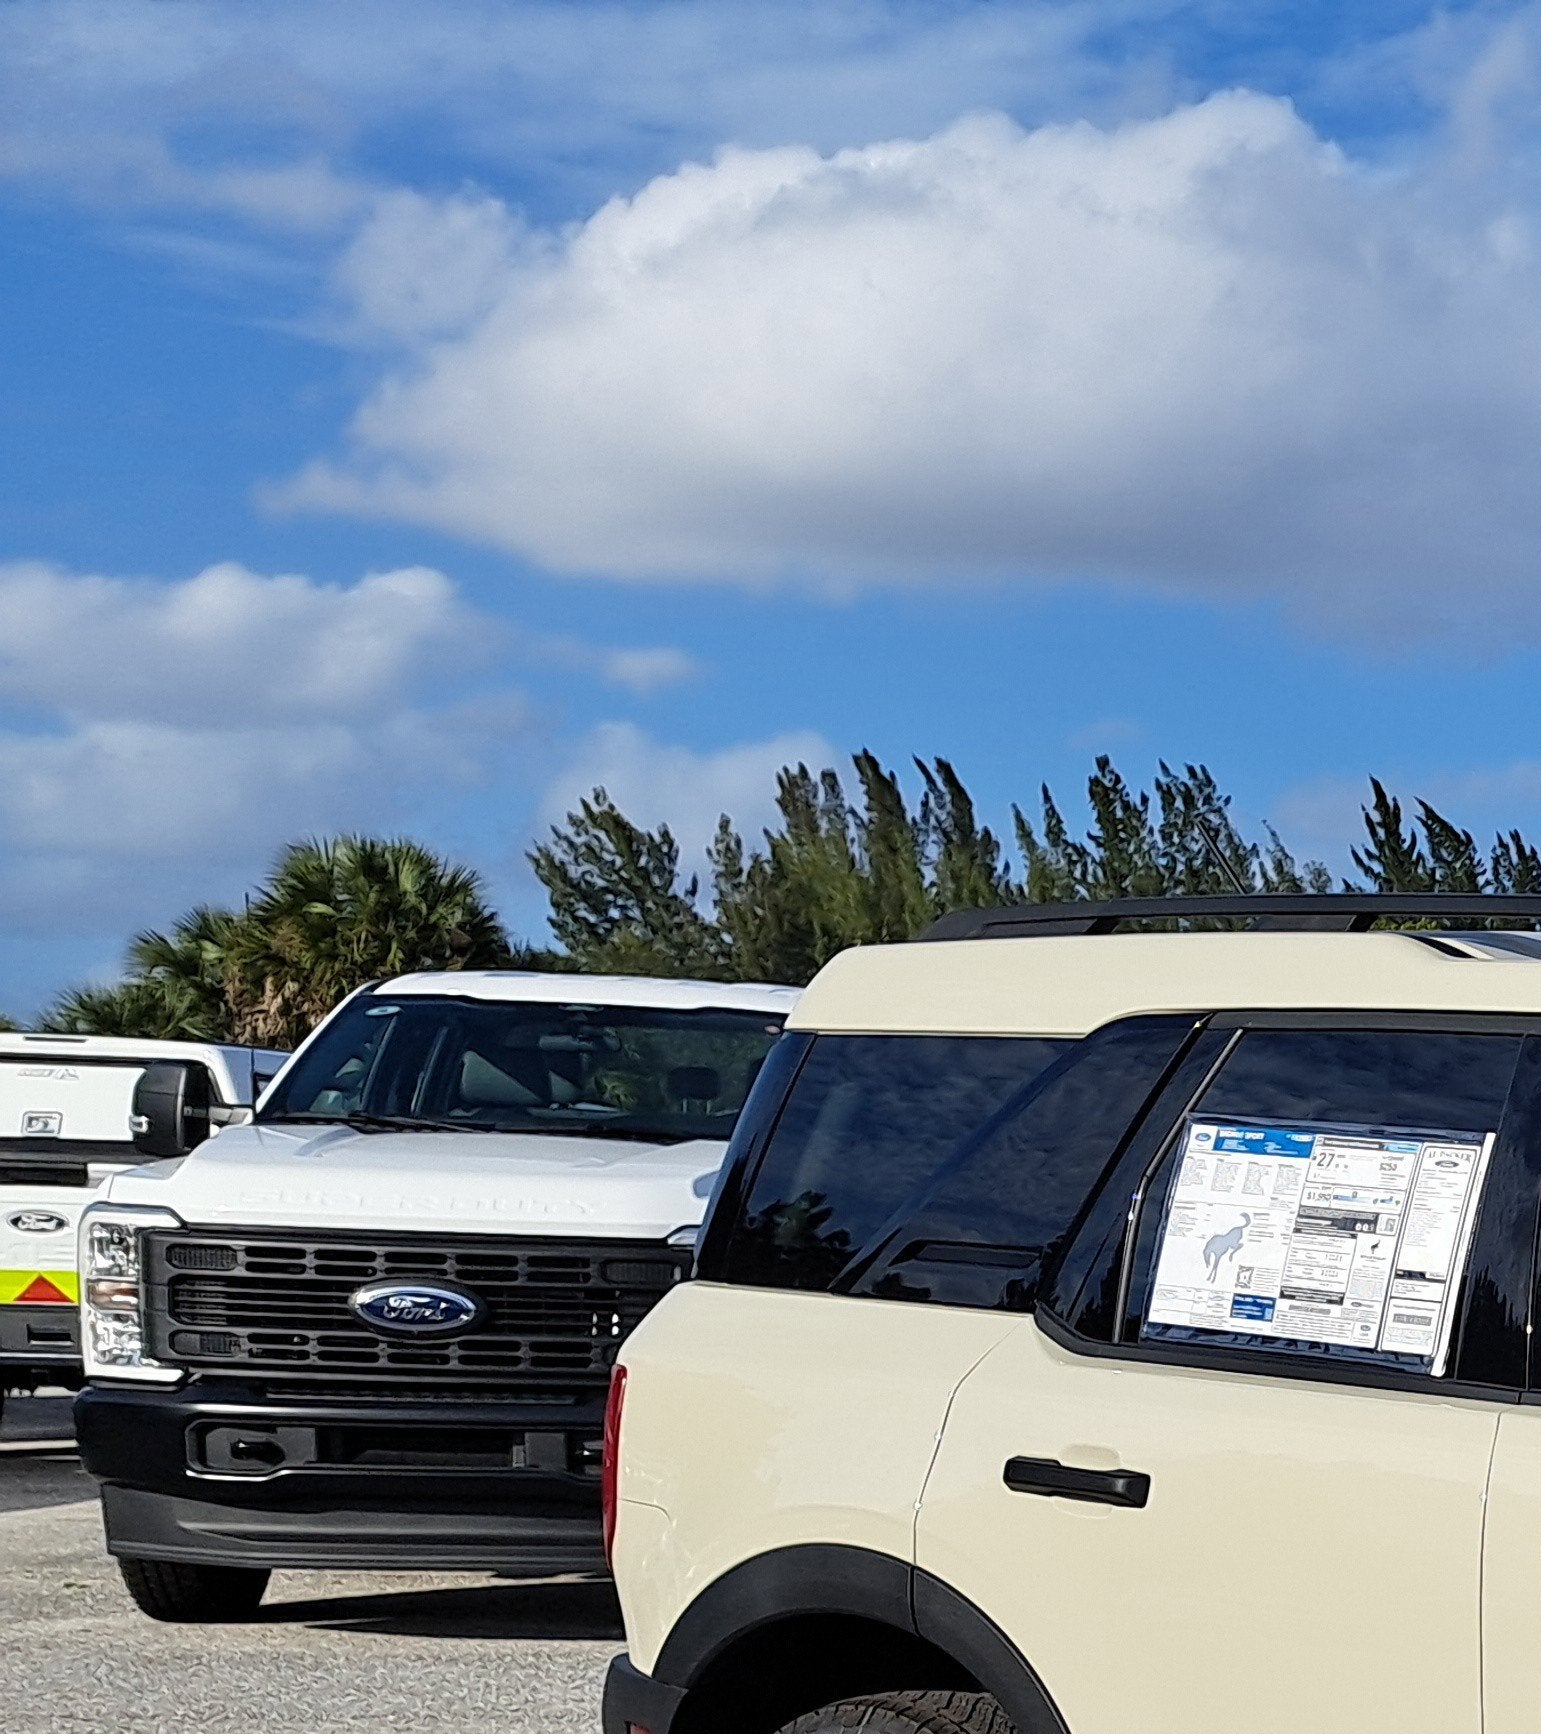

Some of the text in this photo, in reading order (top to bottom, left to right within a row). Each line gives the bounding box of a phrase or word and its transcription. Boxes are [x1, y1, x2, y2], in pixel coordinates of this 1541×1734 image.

[1316, 1151, 1335, 1170] 27
[17, 1214, 60, 1231] Ford
[382, 1294, 450, 1321] Ford
